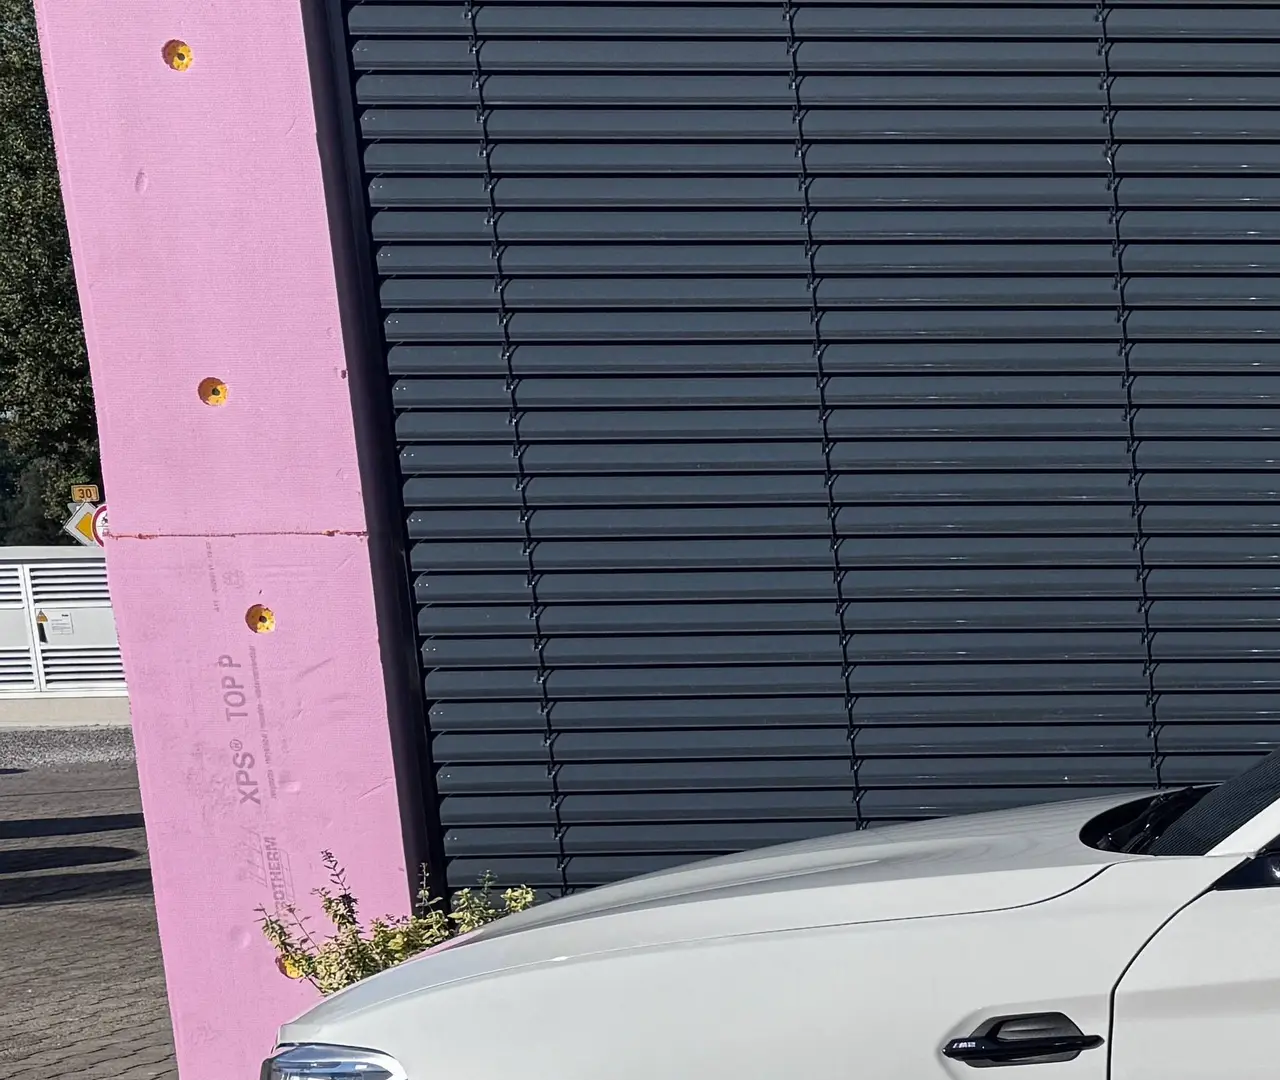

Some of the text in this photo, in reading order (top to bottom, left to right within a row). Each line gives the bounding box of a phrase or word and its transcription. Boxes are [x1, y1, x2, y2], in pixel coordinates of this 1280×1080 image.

[77, 488, 92, 498] 30
[217, 654, 242, 669] P
[221, 675, 248, 722] TOP
